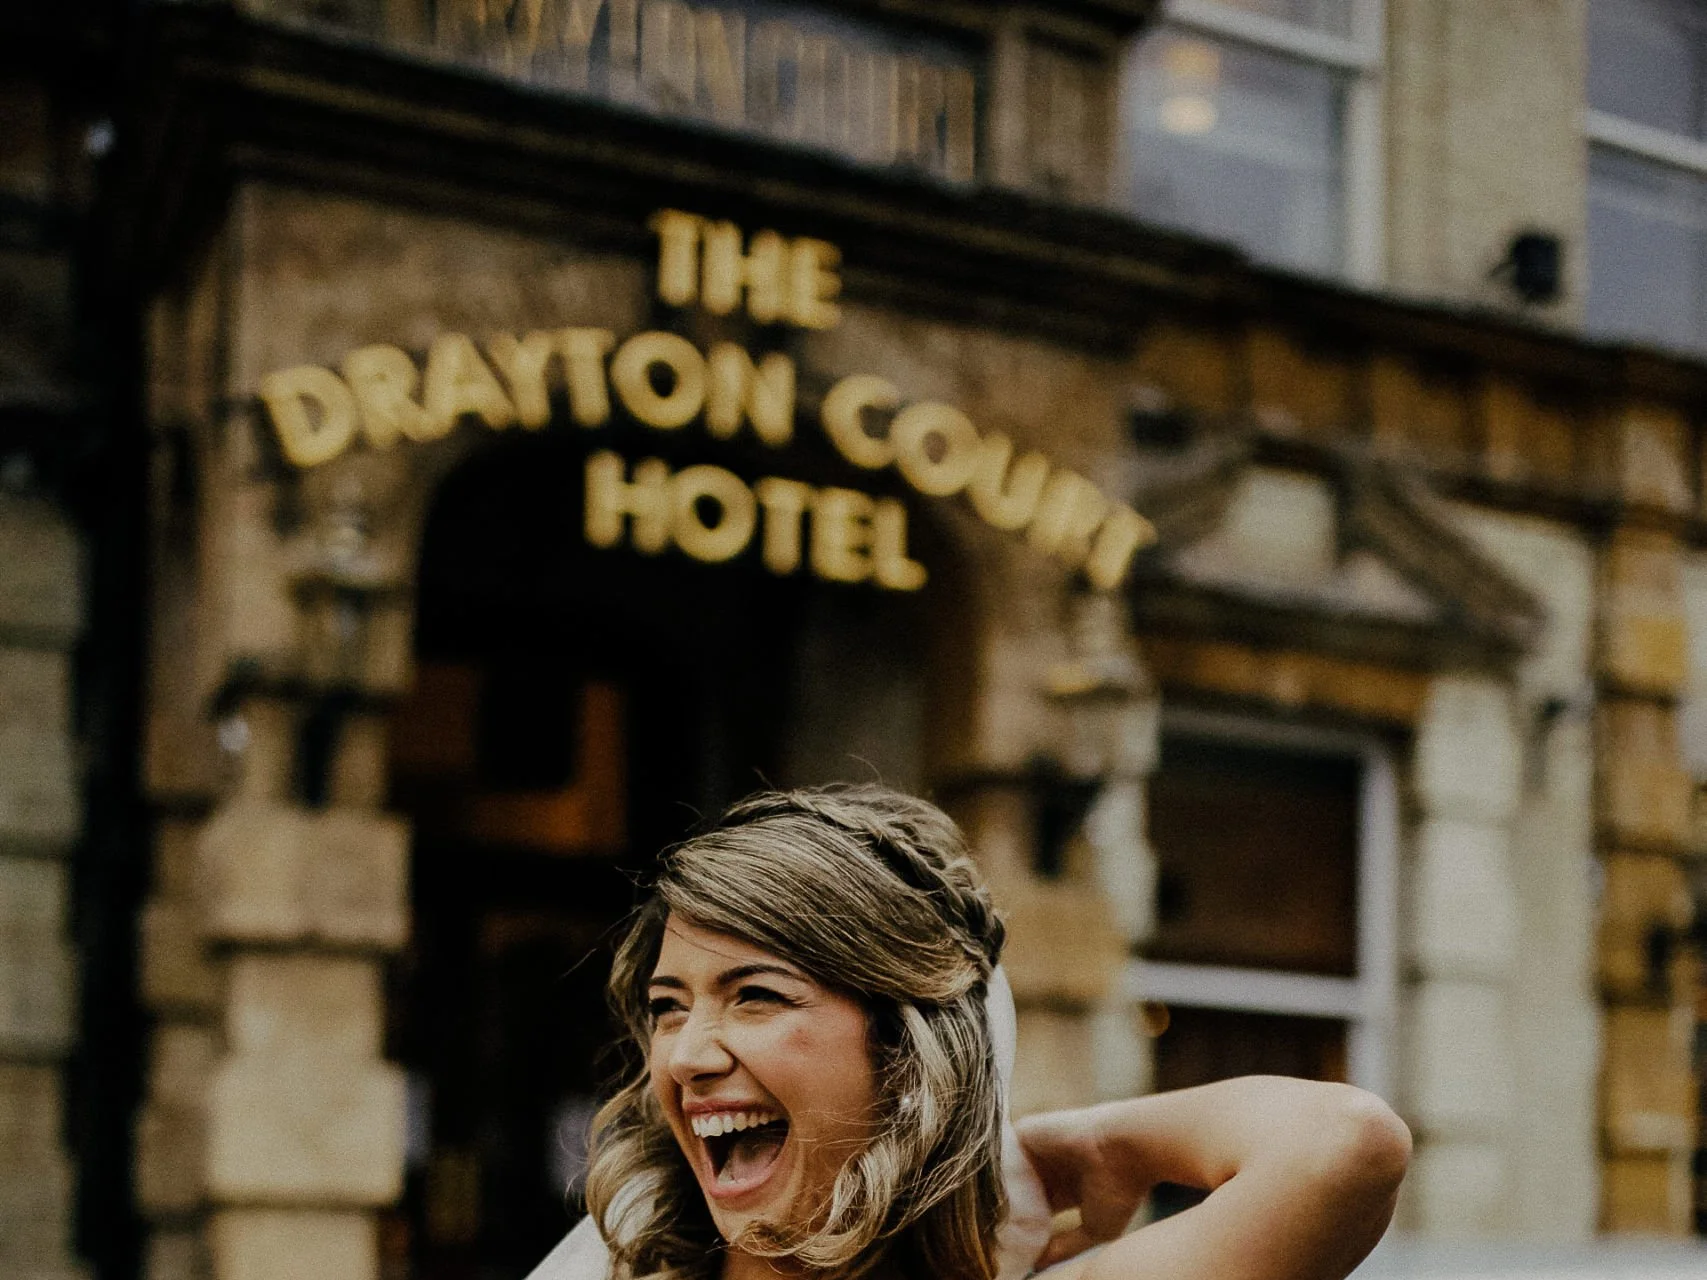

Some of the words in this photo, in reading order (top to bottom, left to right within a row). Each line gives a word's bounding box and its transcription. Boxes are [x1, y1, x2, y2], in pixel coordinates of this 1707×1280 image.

[651, 208, 843, 329] THE
[261, 327, 797, 467] DRAYTON
[822, 374, 1158, 590] COURT
[583, 449, 928, 590] HOTEL
